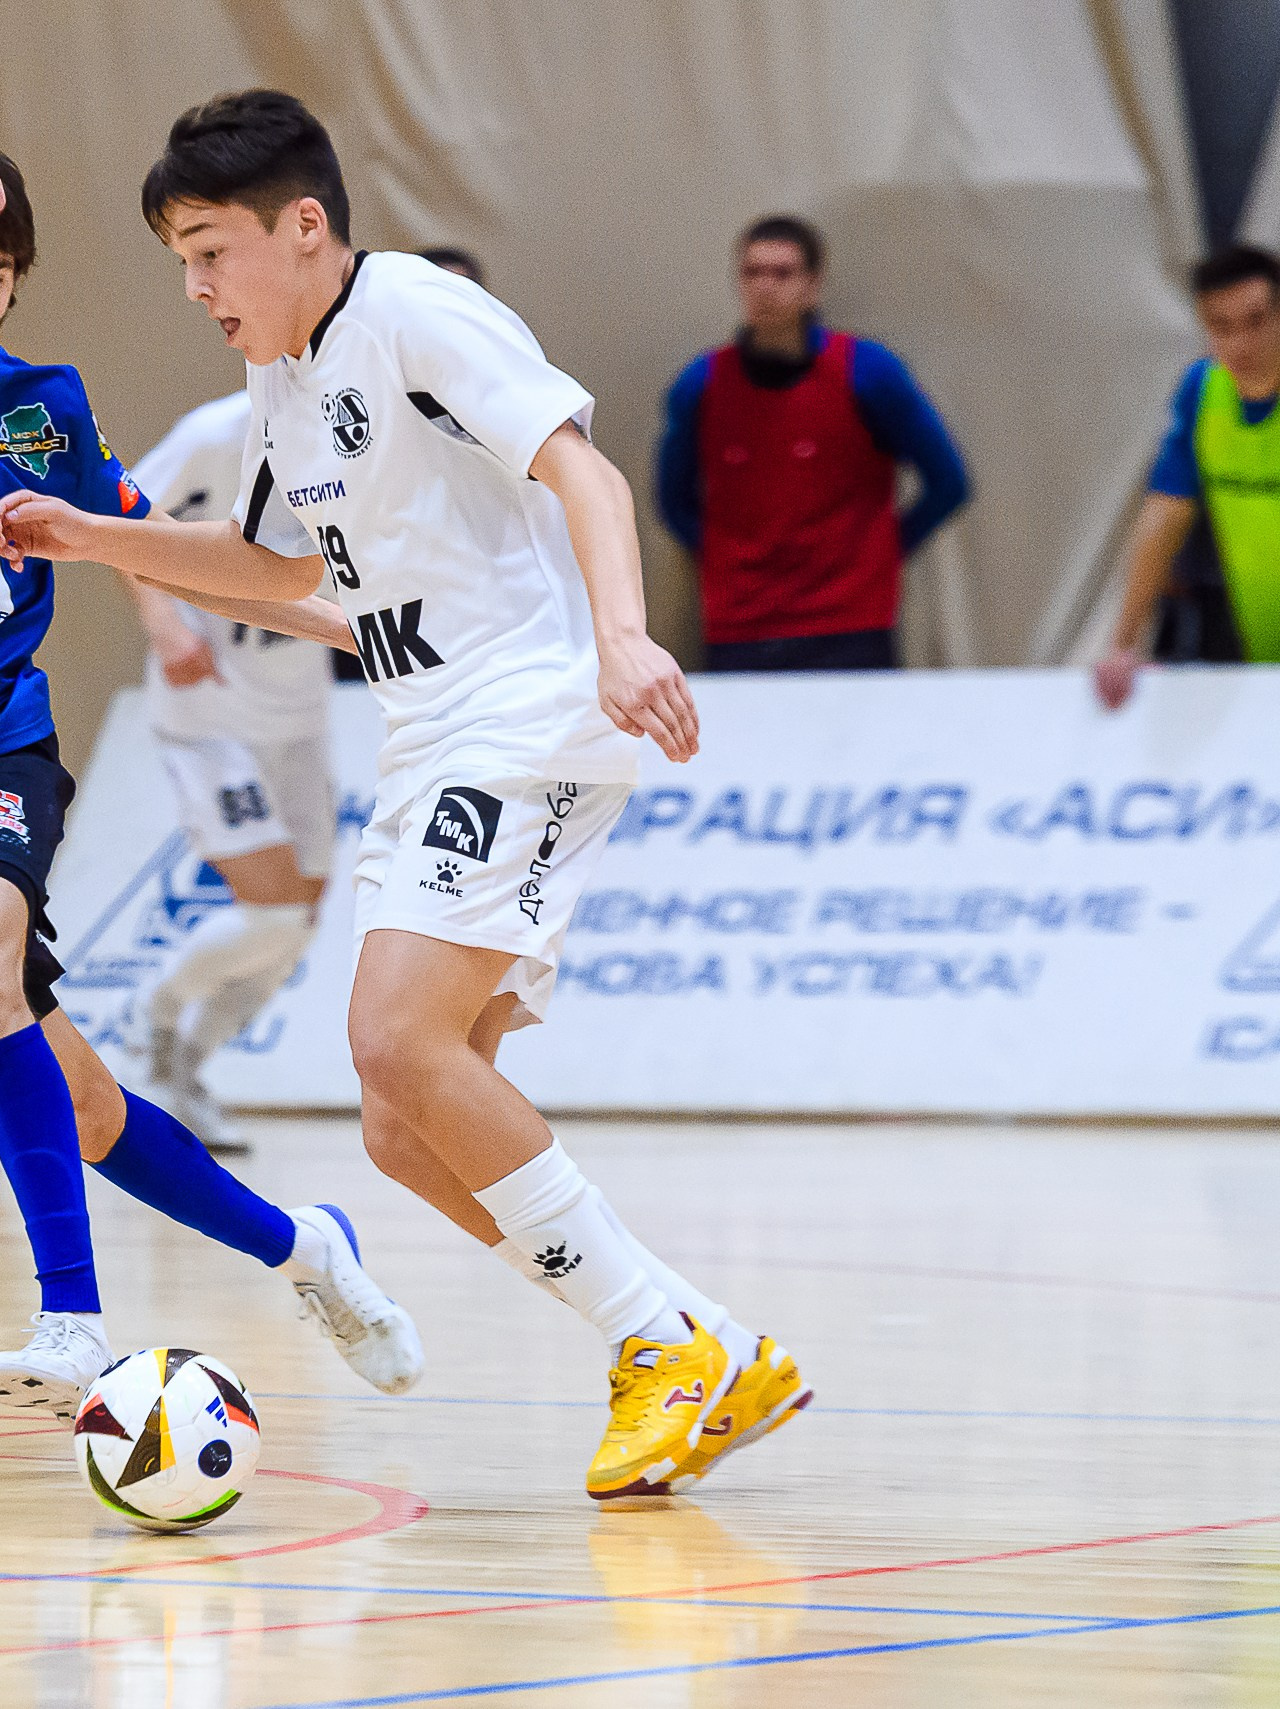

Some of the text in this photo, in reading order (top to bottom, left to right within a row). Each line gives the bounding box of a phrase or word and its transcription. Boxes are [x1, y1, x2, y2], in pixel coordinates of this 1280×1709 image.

[287, 480, 346, 507] БЕТСИТИ
[347, 599, 445, 682] МК
[607, 782, 970, 856] РАЦИЯ
[420, 880, 463, 897] KELME
